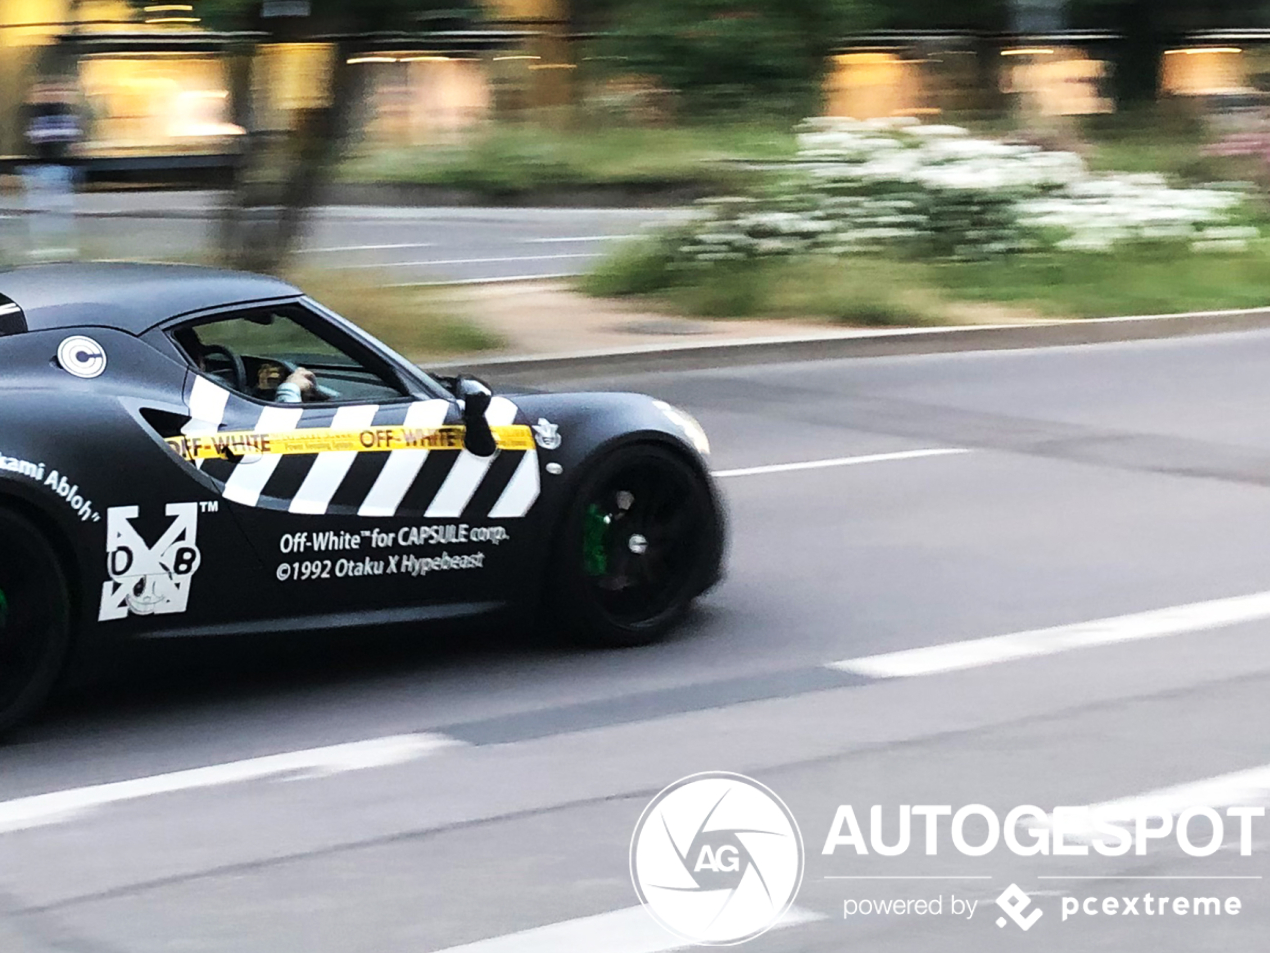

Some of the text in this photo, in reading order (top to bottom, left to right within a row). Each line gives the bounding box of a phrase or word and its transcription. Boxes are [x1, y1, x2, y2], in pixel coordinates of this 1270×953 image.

[370, 528, 396, 548] for
[397, 523, 470, 546] CAPSULE
[334, 556, 384, 578] Otaku
[385, 555, 399, 574] X
[400, 551, 486, 577] Hypebeast
